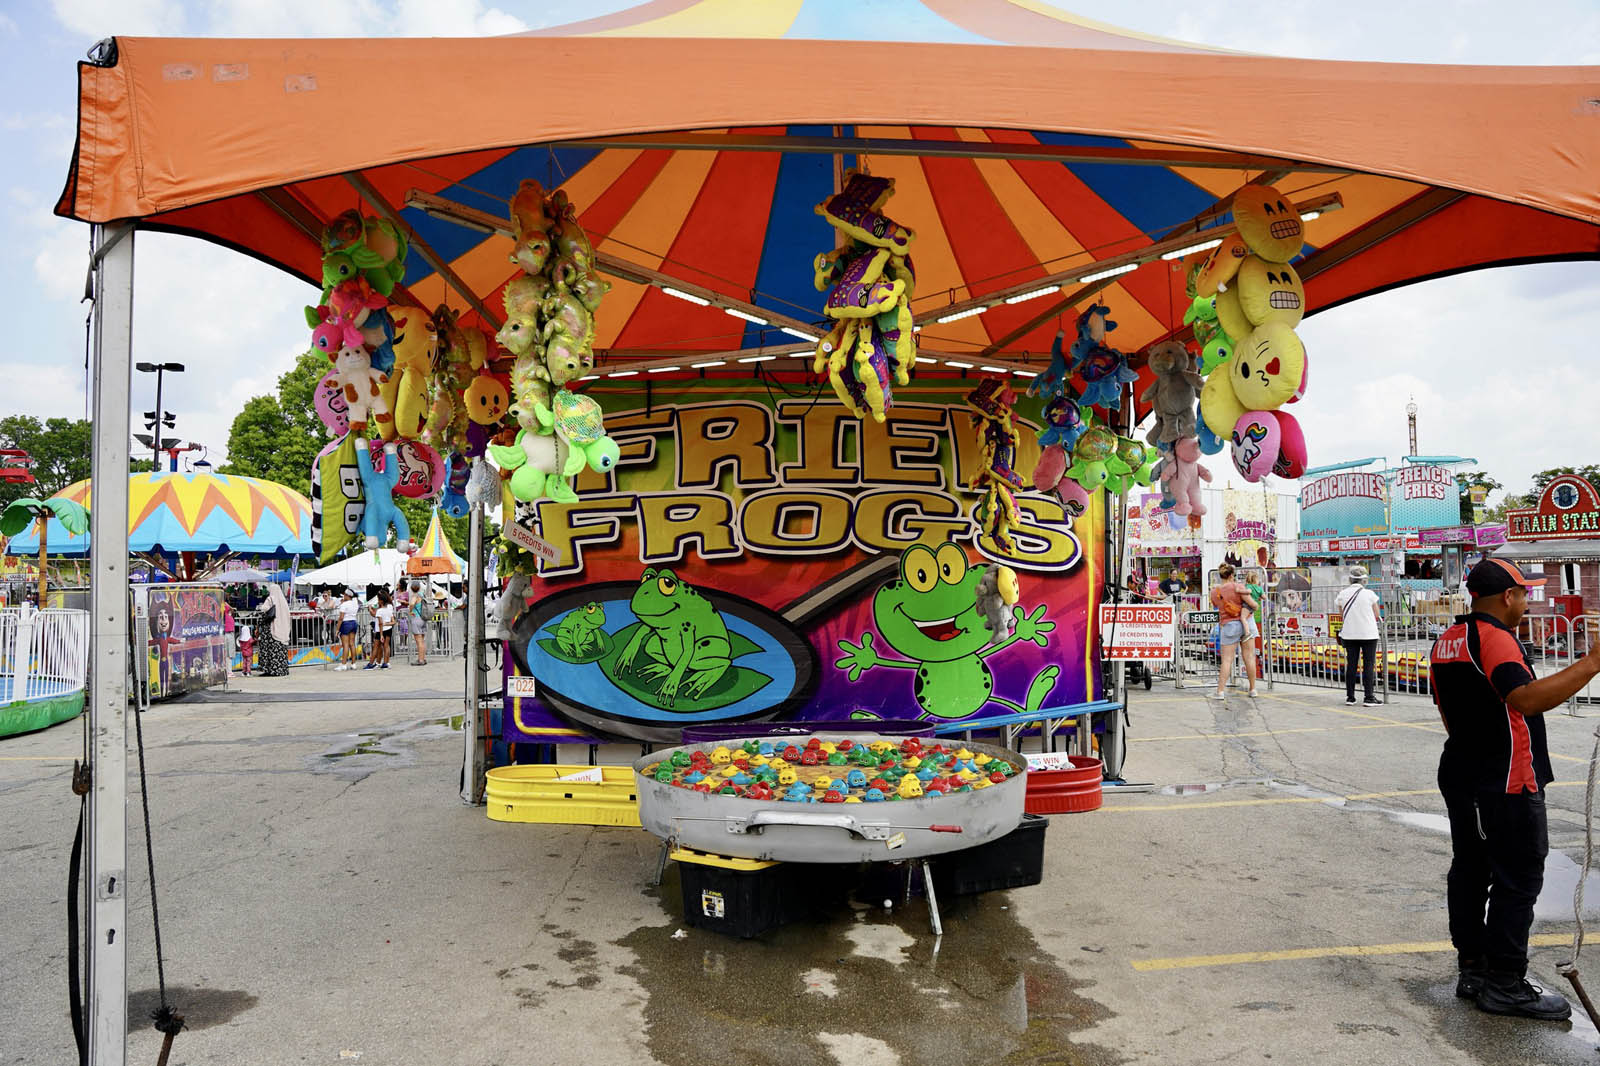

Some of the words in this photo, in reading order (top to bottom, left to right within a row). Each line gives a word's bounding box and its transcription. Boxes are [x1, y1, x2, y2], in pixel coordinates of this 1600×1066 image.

[1396, 466, 1452, 486] FRENCH
[1302, 474, 1346, 510] FRENCH
[1347, 473, 1386, 500] FRIES
[1404, 482, 1445, 500] FRIES
[536, 486, 1083, 577] FROGS
[1513, 515, 1558, 533] TRAIN
[1562, 511, 1600, 531] STAT
[512, 528, 517, 536] 5
[518, 531, 542, 551] CREDITS
[543, 546, 554, 558] WIN
[1104, 610, 1133, 622] FRIED
[1136, 610, 1169, 622] FROGS
[1194, 614, 1214, 622] ENTER
[1287, 618, 1299, 629] 4
[516, 680, 533, 692] 022
